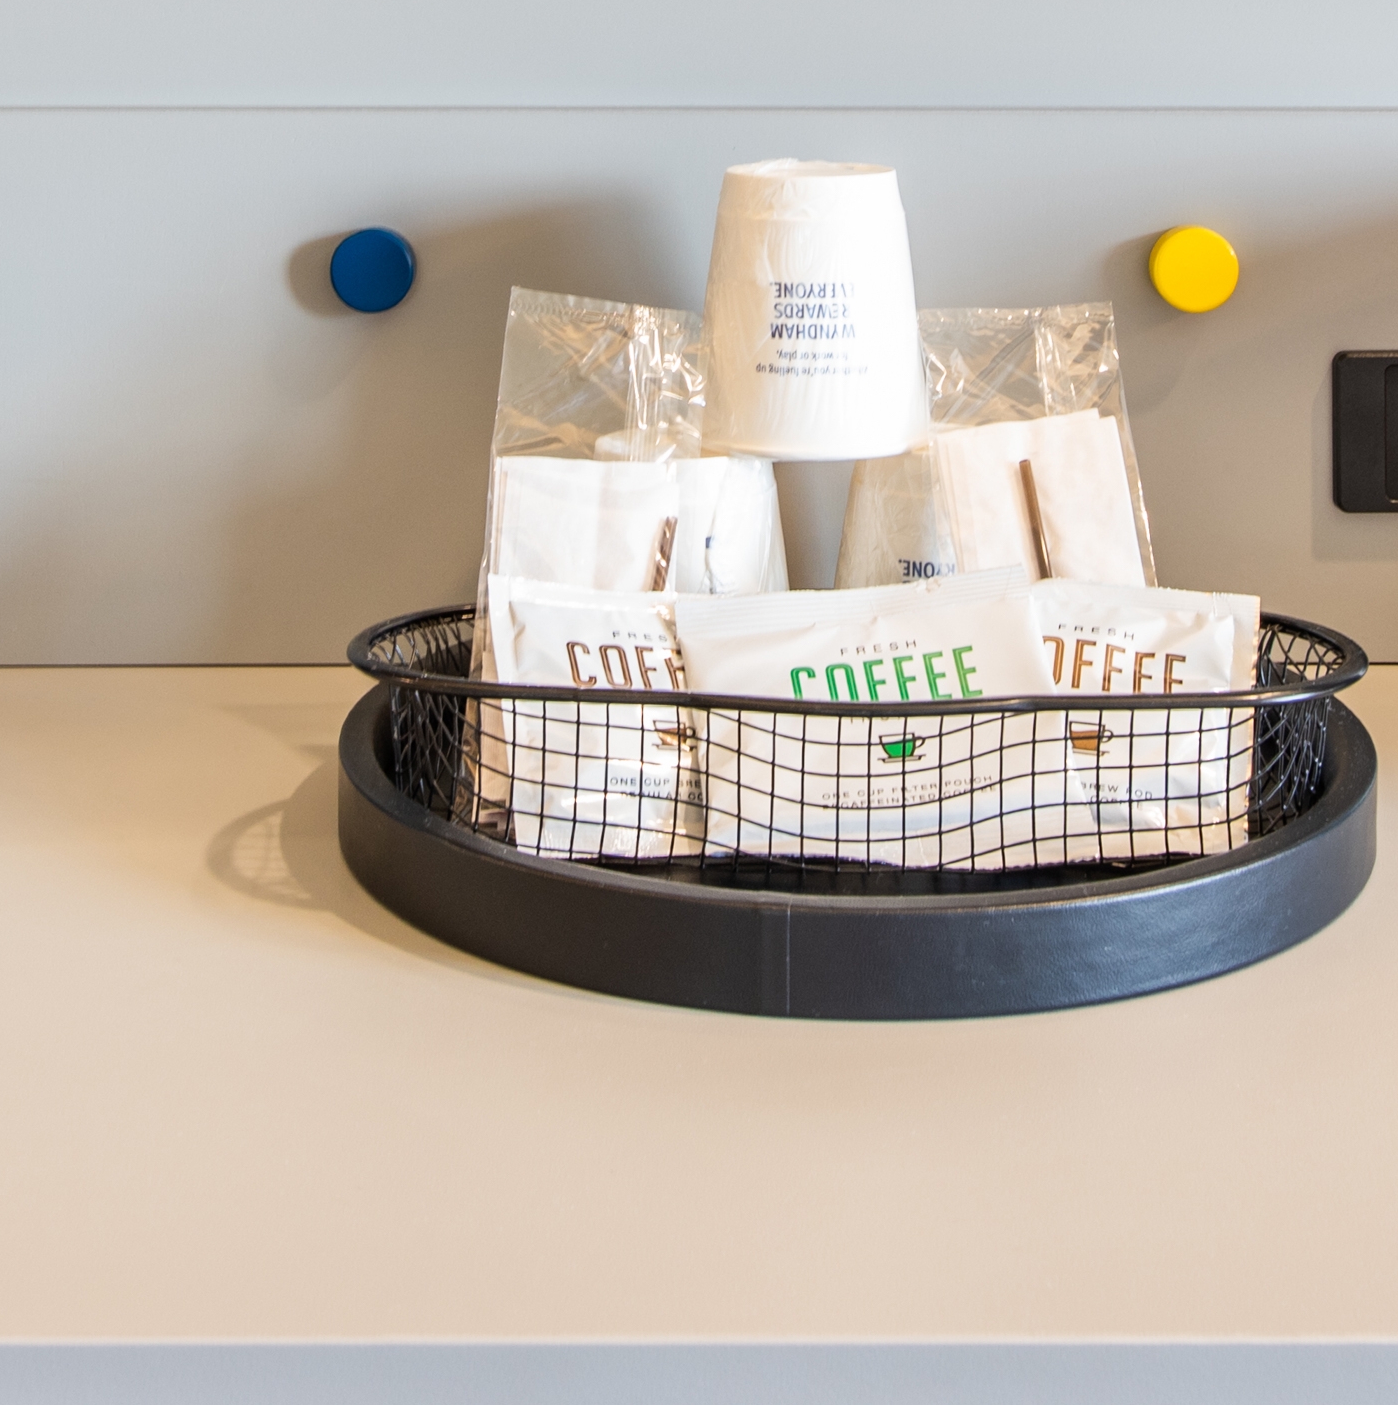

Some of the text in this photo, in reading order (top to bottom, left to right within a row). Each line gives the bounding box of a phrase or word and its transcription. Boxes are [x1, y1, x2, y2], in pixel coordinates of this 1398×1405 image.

[773, 302, 850, 319] REWARDS
[770, 323, 855, 339] WYNDHAM
[776, 349, 797, 362] play,
[799, 351, 809, 360] or
[755, 362, 766, 373] up
[768, 363, 799, 377] fueling
[1058, 623, 1135, 640] FRESH
[840, 639, 917, 656] FRESH
[790, 645, 983, 702] COFFEE
[609, 777, 637, 786] ONE
[644, 777, 670, 787] CUP
[822, 775, 993, 800] ONE CUP FLTER POUCH
